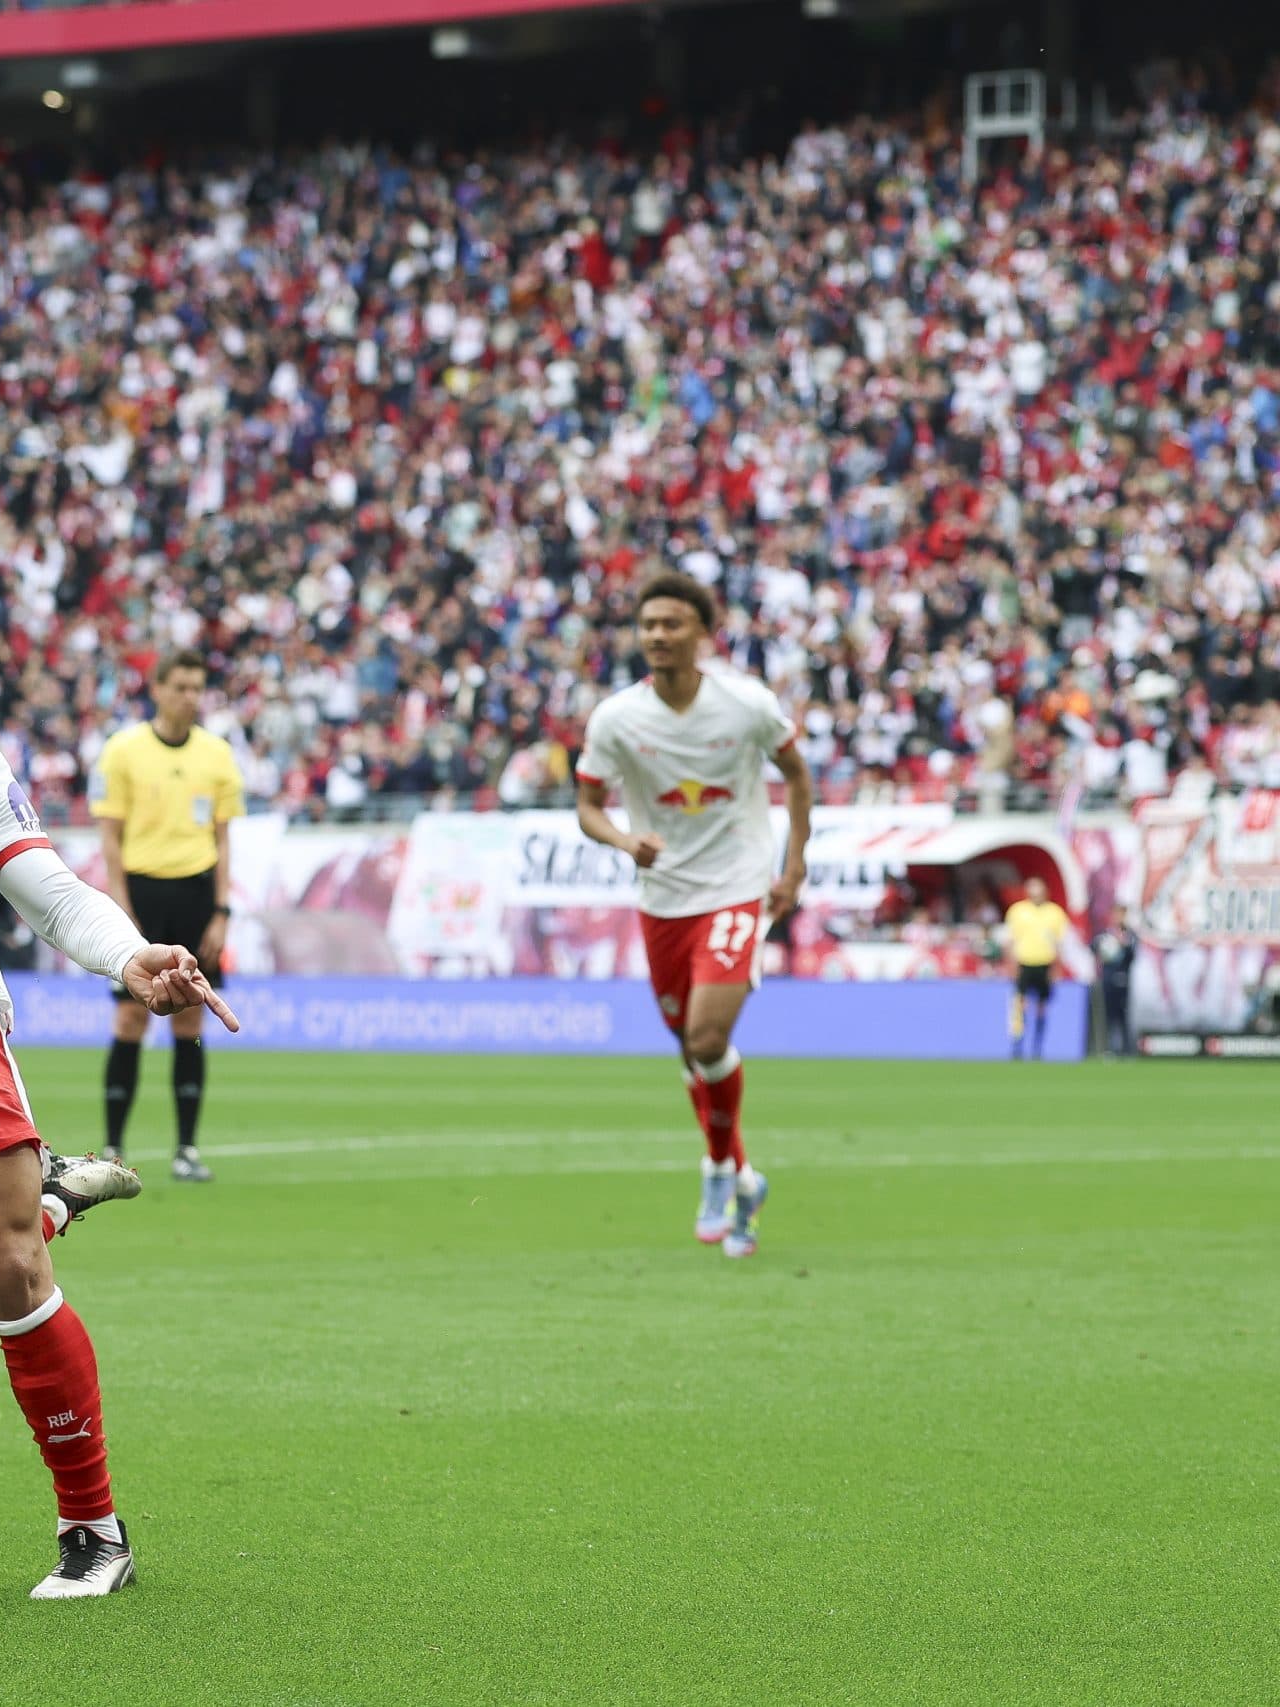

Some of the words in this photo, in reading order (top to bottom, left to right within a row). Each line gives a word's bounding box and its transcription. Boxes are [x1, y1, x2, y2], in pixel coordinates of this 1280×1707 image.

[707, 909, 756, 953] 27
[301, 992, 611, 1046] cryptocurrencies
[46, 1409, 78, 1429] RBL
